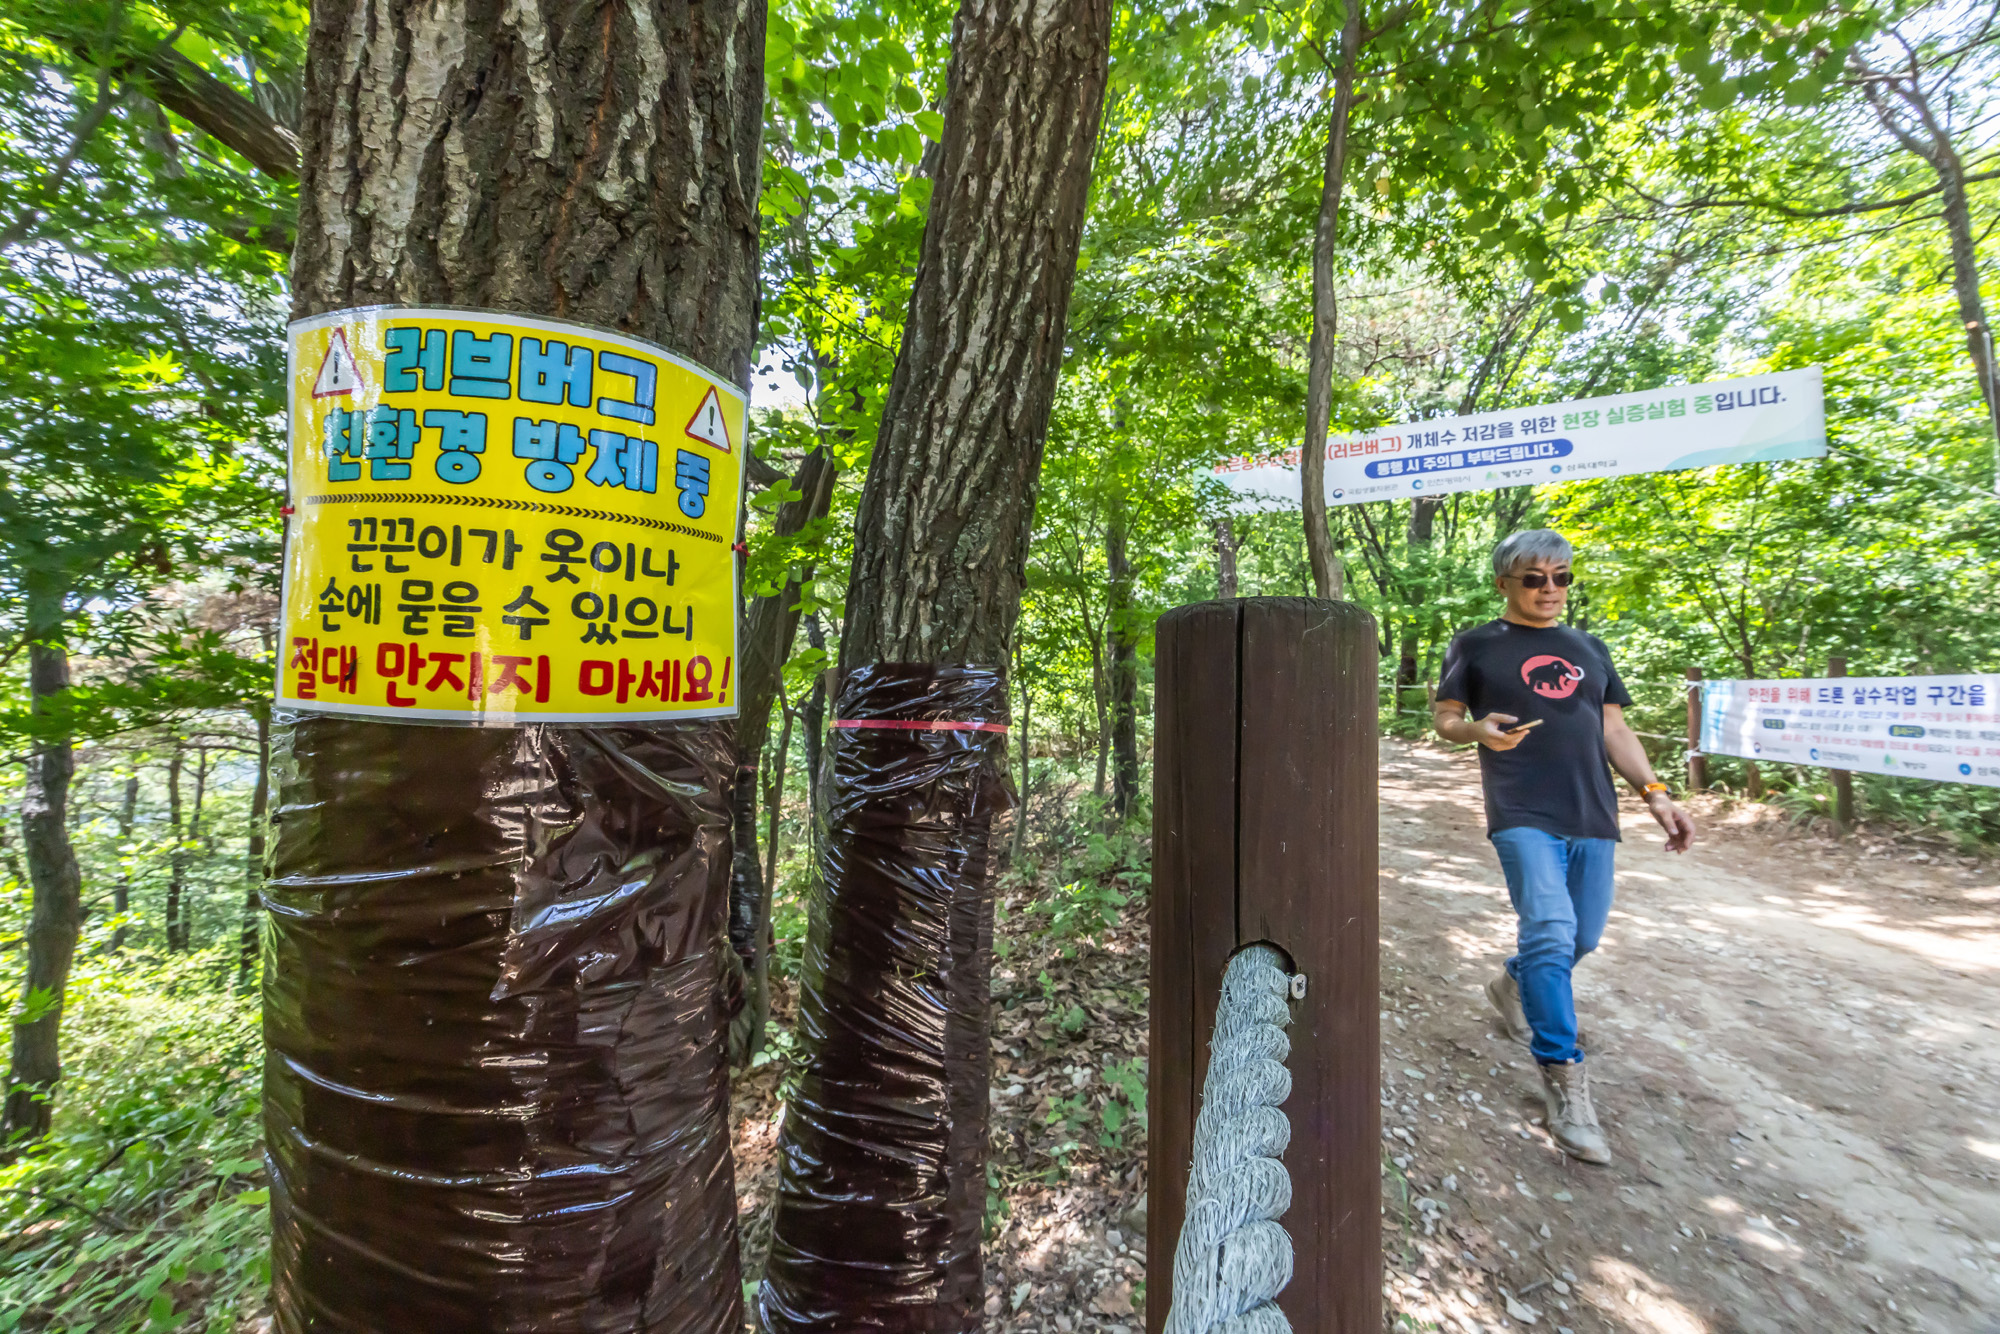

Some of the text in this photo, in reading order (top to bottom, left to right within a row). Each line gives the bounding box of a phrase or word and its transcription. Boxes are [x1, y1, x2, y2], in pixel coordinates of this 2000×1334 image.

[384, 327, 657, 426] 러브버그
[1406, 427, 1456, 450] 개체수
[1462, 421, 1514, 442] 저감을
[1520, 415, 1557, 436] 위한
[1562, 409, 1601, 431] 현장
[1606, 398, 1687, 425] 실증실험
[1694, 385, 1788, 415] 중입니다.
[323, 404, 711, 519] 친환경 방제 중
[1406, 458, 1420, 472] 시
[1423, 453, 1464, 470] 주의를
[1467, 442, 1560, 465] 부탁드립니다.
[347, 517, 680, 585] 끈끈이가 옷이나
[319, 576, 694, 645] 손에 묻을 수 있으니
[291, 637, 731, 707] 절대 만지지 마세요!
[1818, 686, 1844, 704] 드론
[1852, 686, 1917, 705] 살수작업
[1926, 684, 1986, 706] 구간을
